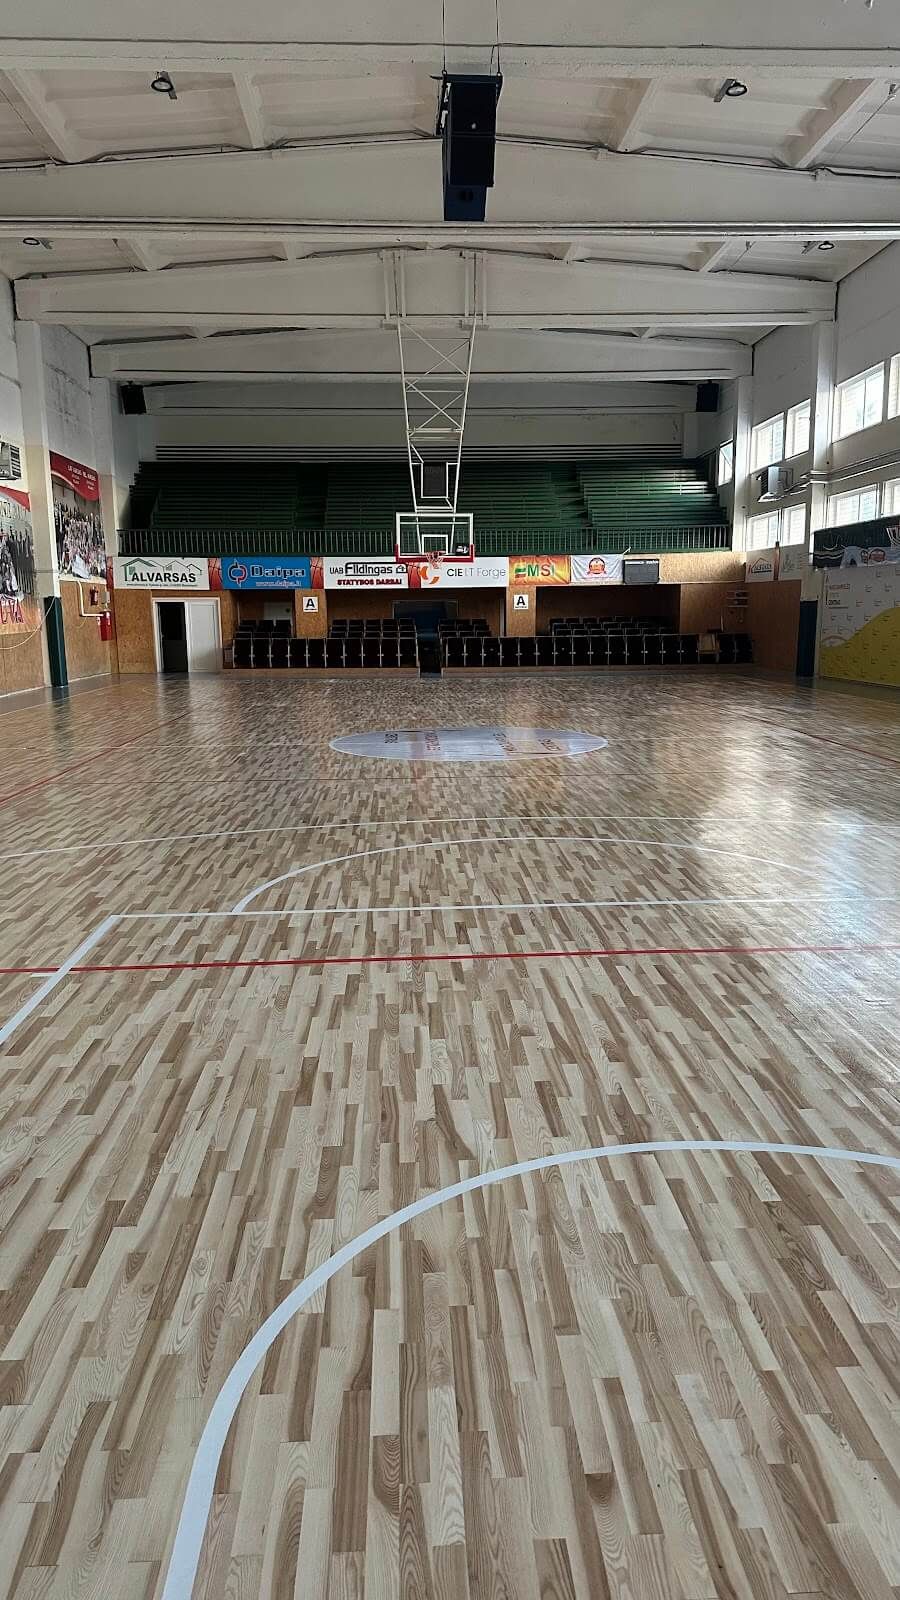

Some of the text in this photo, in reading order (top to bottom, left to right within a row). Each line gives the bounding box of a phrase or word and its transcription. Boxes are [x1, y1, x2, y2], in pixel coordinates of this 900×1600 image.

[250, 564, 306, 580] Daipa
[329, 567, 344, 575] UAB
[447, 568, 463, 577] CIE
[476, 568, 506, 579] Forge
[131, 572, 196, 583] ALVARSAS
[305, 598, 315, 608] A
[516, 595, 526, 606] A
